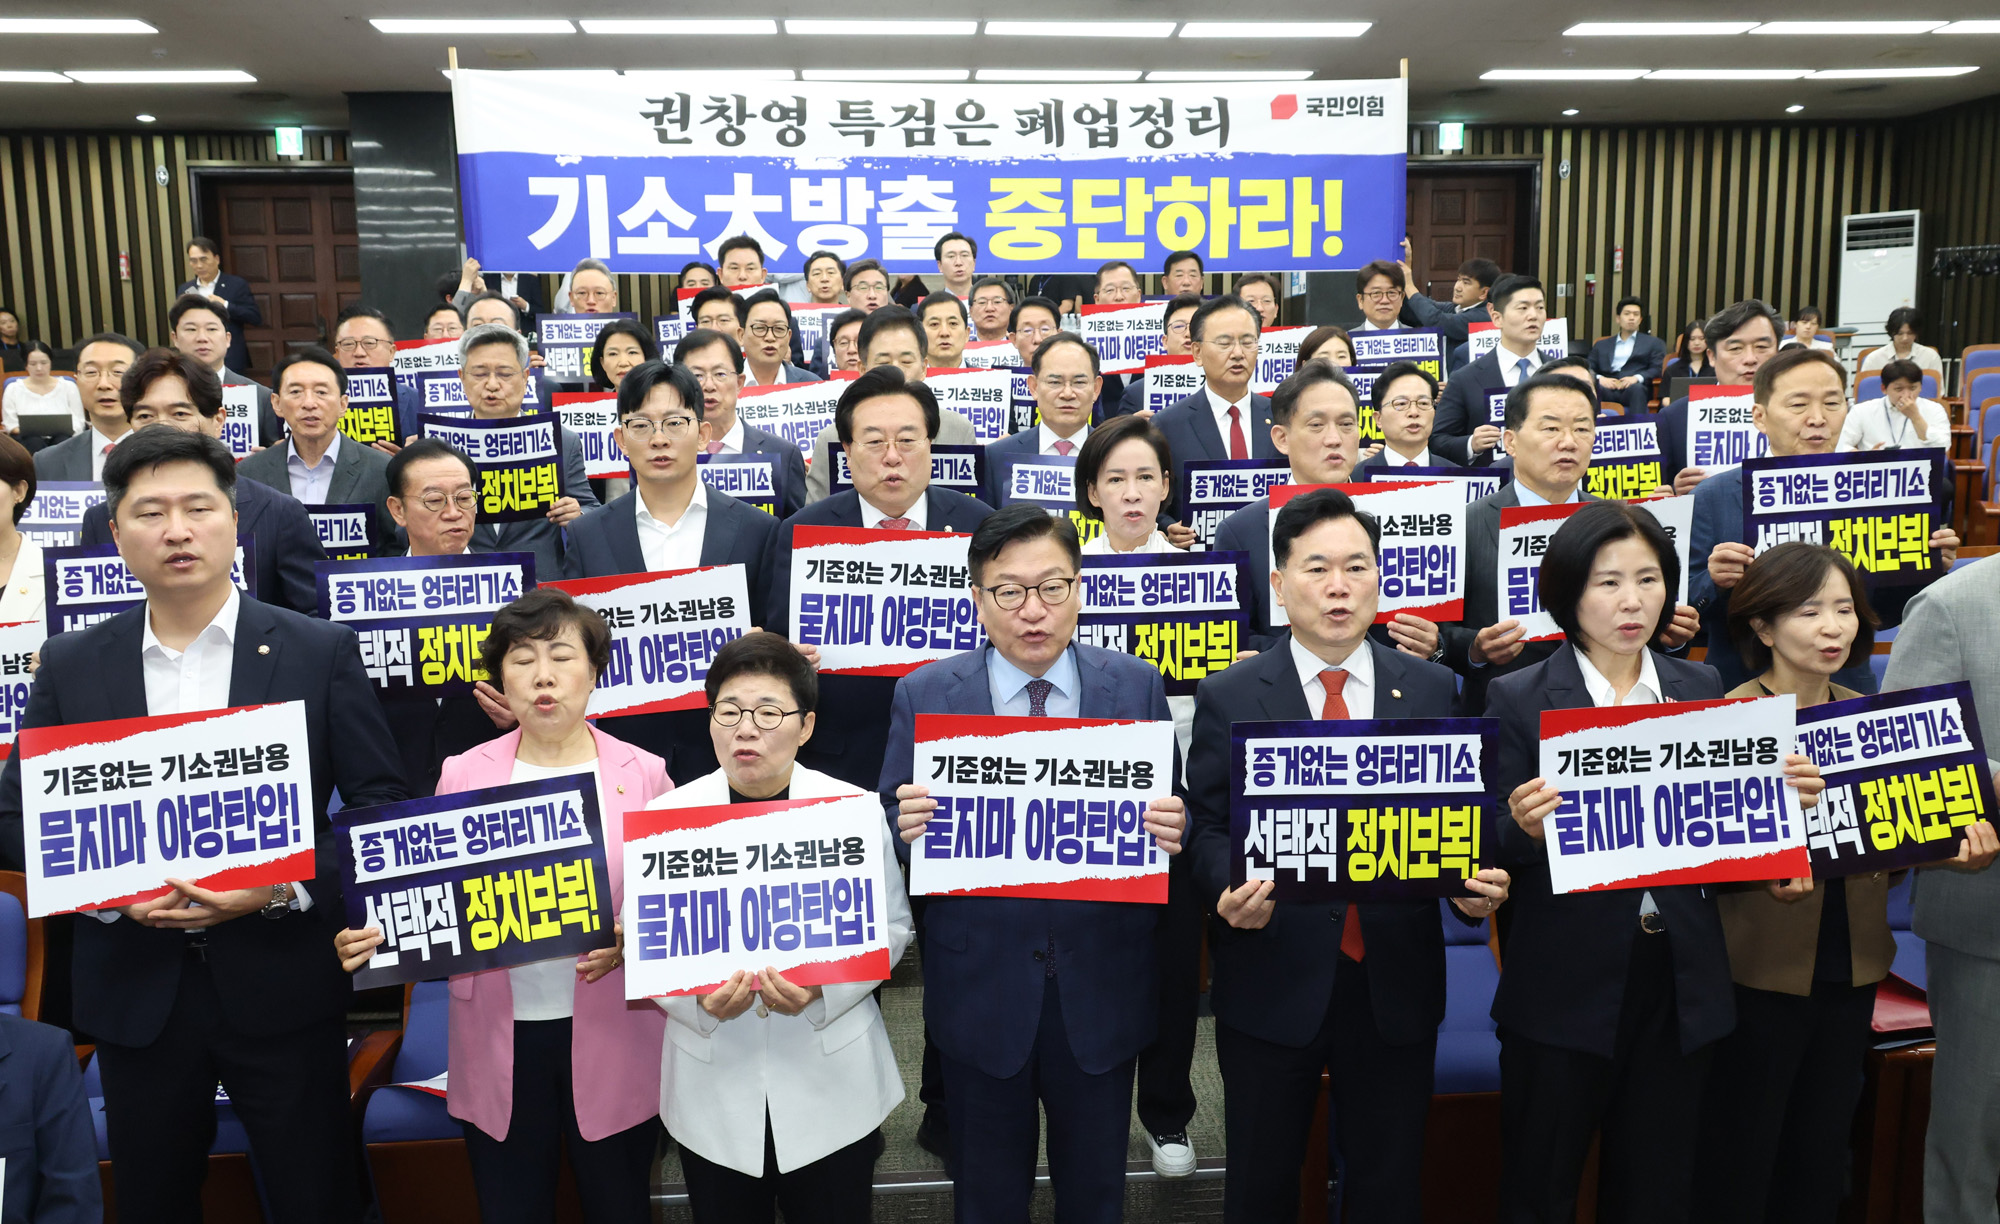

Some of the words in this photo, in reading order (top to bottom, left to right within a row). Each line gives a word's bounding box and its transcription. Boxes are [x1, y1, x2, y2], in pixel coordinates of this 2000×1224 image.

[639, 91, 808, 147] 권창영
[828, 97, 1000, 147] 특검은
[1013, 97, 1231, 149] 폐업정리
[1305, 95, 1385, 118] 국민의힘
[527, 172, 959, 261] 기소大방출
[985, 175, 1343, 262] 중단하라!
[545, 323, 582, 340] 증거없는
[1087, 320, 1124, 332] 기준없는
[1126, 318, 1163, 331] 기소권남
[1355, 338, 1391, 356] 증거없는
[1393, 337, 1436, 354] 엉터리기소
[394, 356, 432, 369] 기준없는
[543, 347, 581, 377] 선택적
[1152, 374, 1197, 388] 기준없는
[428, 382, 468, 403] 증거없
[947, 387, 1003, 403] 기소권남용
[561, 412, 607, 426] 기준없는
[484, 424, 553, 458] 엉터리기소
[480, 462, 560, 514] 정치보복!
[1015, 469, 1072, 496] 증거없는
[1195, 474, 1248, 499] 증거없는
[1758, 473, 1829, 508] 증거없는
[1834, 461, 1926, 502] 엉터리기소
[1376, 513, 1453, 537] 소권남용
[1828, 512, 1932, 573] 정치보복!
[64, 562, 145, 599] 증거없는
[335, 577, 417, 615] 증거없는
[421, 571, 519, 610] 엉터리기소
[805, 558, 884, 586] 기준없는
[888, 561, 975, 590] 기소권남
[1081, 573, 1136, 607] 거없는
[1140, 570, 1233, 606] 엉터리기소
[639, 596, 736, 625] 기소권남용
[798, 592, 875, 647] 묻지마
[1134, 620, 1239, 681] 정치보복!
[1557, 745, 1652, 778] 기준없는
[1659, 736, 1779, 771] 기소권남용
[1795, 726, 1855, 768] 거없는
[1856, 707, 1963, 760] 엉터리기소
[43, 759, 153, 797] 기준없는
[160, 743, 290, 783] 기소권남용
[931, 755, 1028, 786] 기준없는
[1033, 757, 1155, 790] 기소권남용
[1252, 745, 1348, 788] 증거없는
[1355, 743, 1476, 787] 엉터리기소
[924, 795, 1017, 860] 묻지마
[1554, 784, 1645, 856] 묻지마
[1653, 775, 1791, 849] 야당탄압!
[1859, 763, 1987, 852] 정치보복!
[39, 800, 147, 879] 묻지마
[156, 782, 302, 862] 야당탄압!
[359, 821, 459, 873] 증거없는
[462, 800, 582, 856] 엉터리기소
[1243, 808, 1338, 882] 선택적
[1346, 805, 1482, 882] 정치보복!
[642, 846, 739, 880] 기준없는
[745, 836, 865, 873] 기소권남용
[364, 881, 462, 970] 선택적
[462, 858, 601, 952] 정치보복!
[637, 887, 732, 961] 묻지마
[740, 876, 876, 953] 야당탄압!
